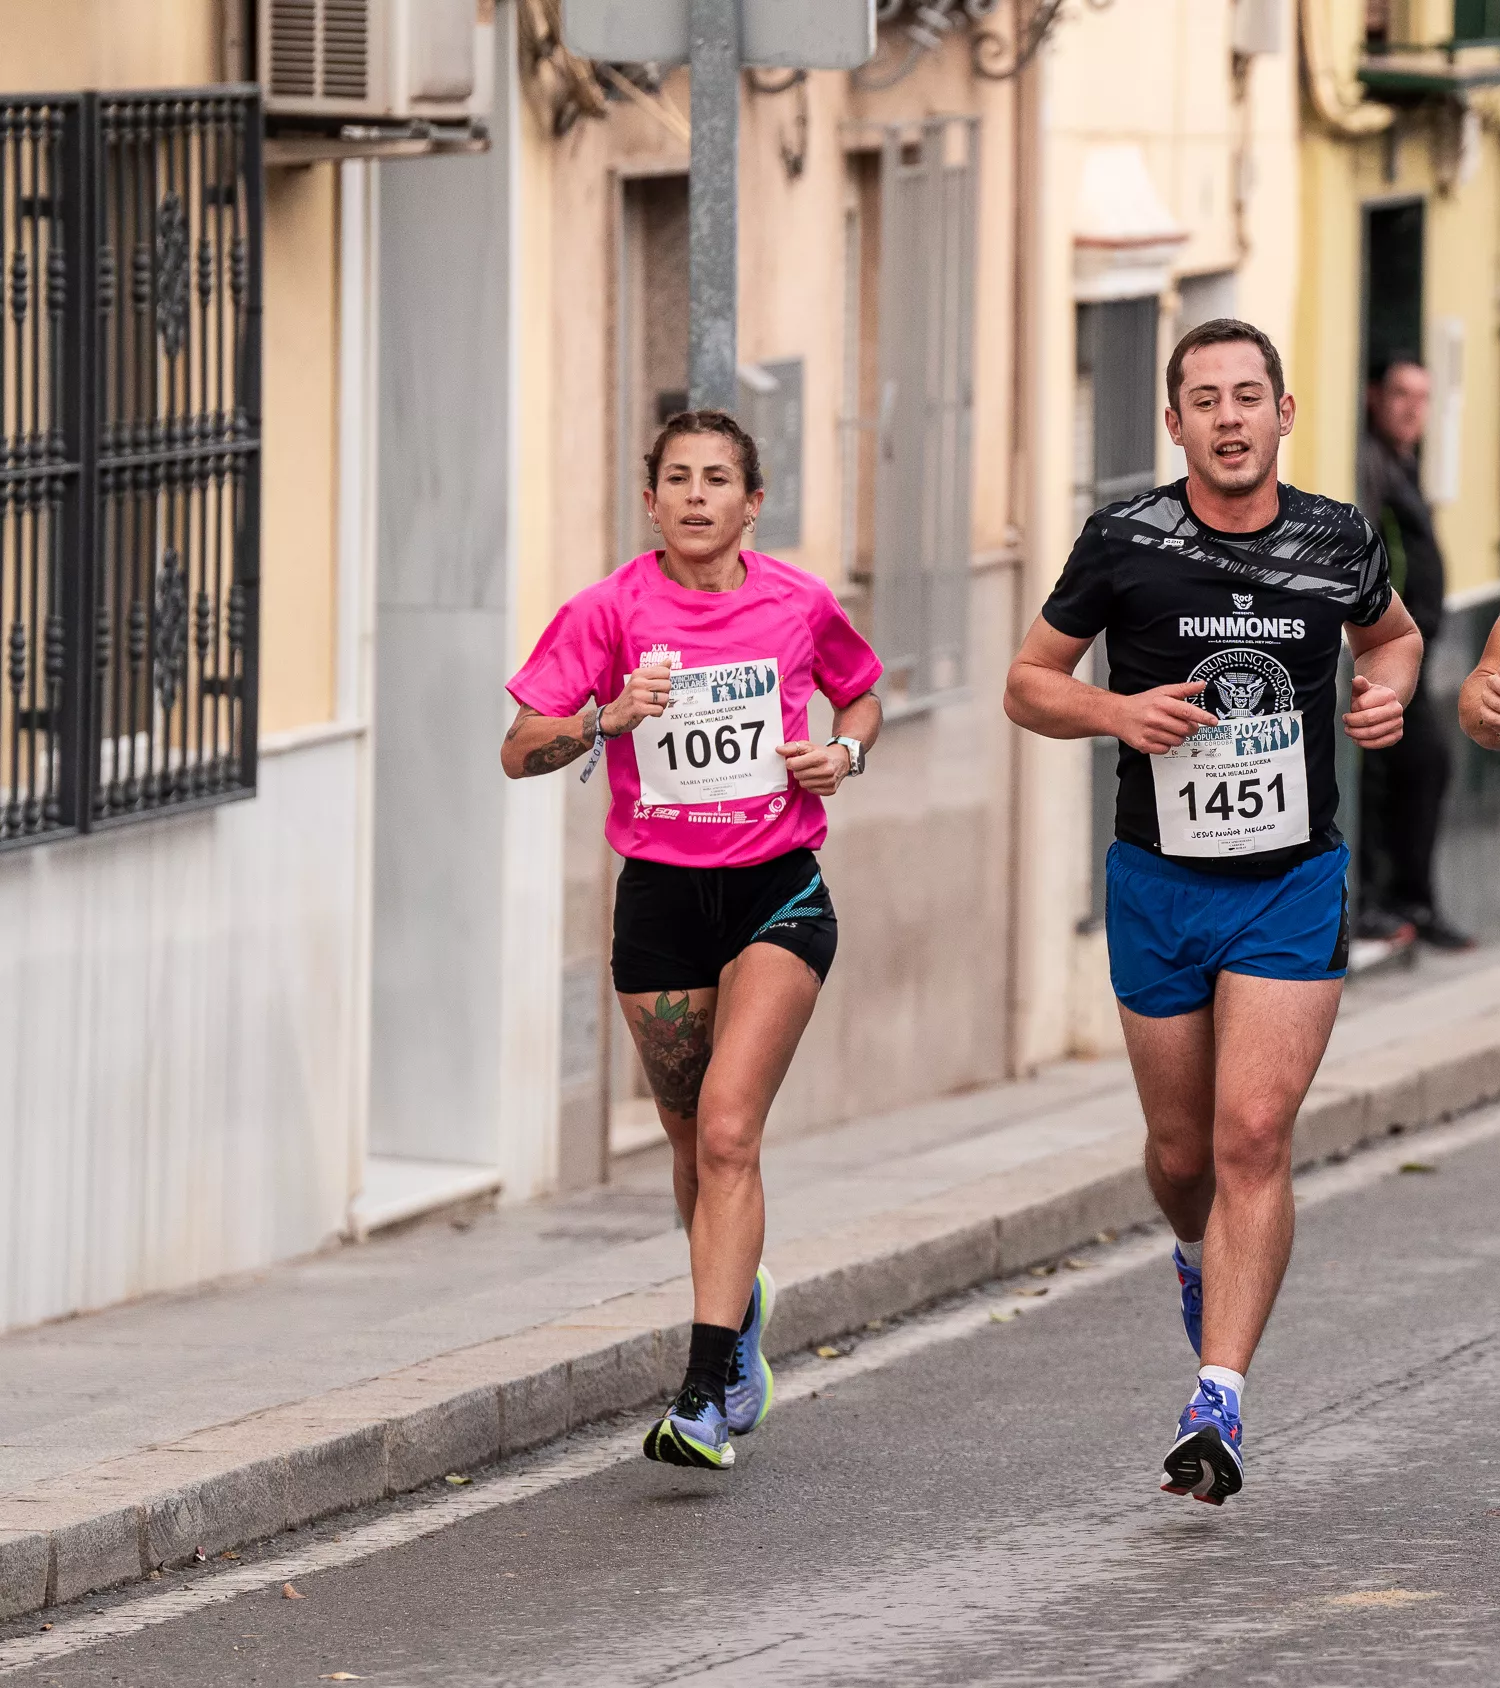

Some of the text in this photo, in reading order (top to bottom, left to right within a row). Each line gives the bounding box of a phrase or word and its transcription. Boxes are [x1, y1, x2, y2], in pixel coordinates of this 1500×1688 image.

[1232, 593, 1253, 602] Rock
[1179, 617, 1305, 639] RUNMONES
[640, 650, 681, 662] CARRERA
[708, 667, 747, 685] 2024
[672, 680, 708, 690] OPULARES
[705, 715, 733, 723] IGUALDAD
[1234, 721, 1271, 738] 2024
[1192, 733, 1232, 741] POPULARES
[657, 720, 765, 770] 1067
[1250, 758, 1271, 766] LUCENA
[1228, 768, 1257, 776] IGUALDAD
[702, 776, 728, 784] POYATO
[729, 772, 752, 780] MEDINA
[1179, 773, 1285, 821] 1451
[1244, 824, 1276, 834] MELLADO
